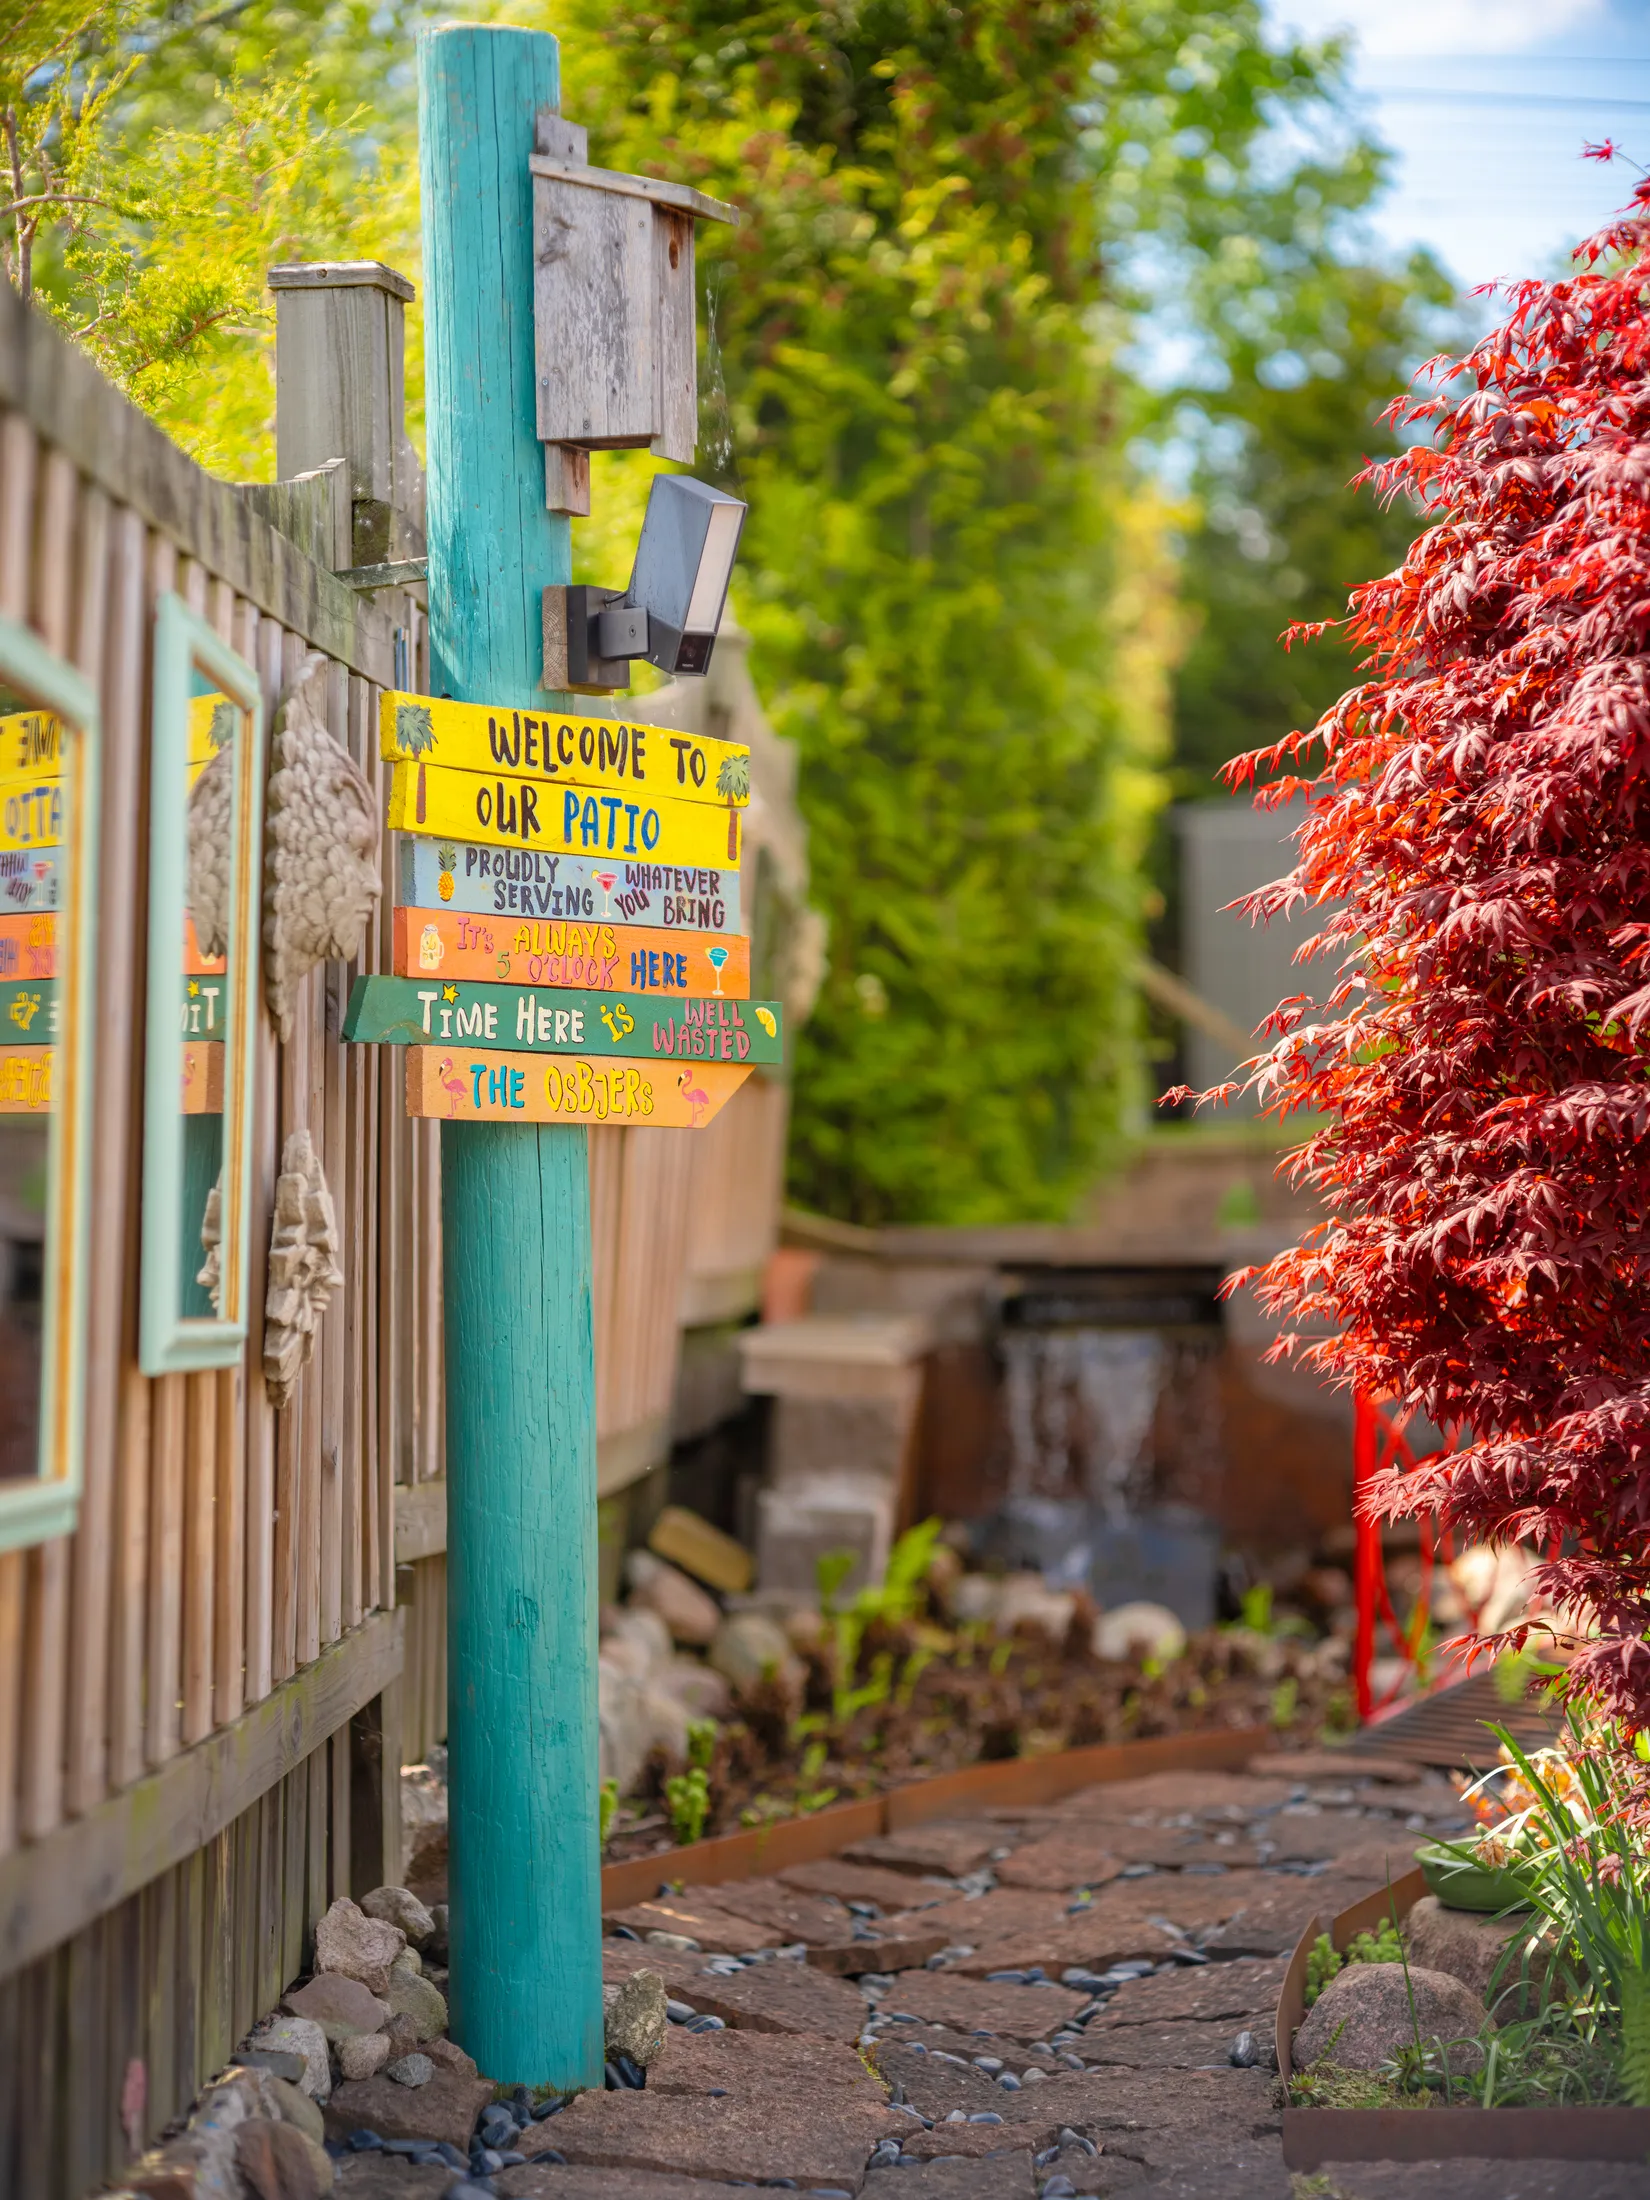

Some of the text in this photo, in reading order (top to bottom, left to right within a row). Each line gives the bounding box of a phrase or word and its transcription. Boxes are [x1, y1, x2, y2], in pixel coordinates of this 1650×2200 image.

[488, 711, 706, 788] WELCOME TO
[476, 781, 660, 854] OUR PATIO
[465, 846, 559, 884] PROUDLY
[625, 863, 720, 896] WHATEVER
[493, 880, 594, 916] SERVING
[614, 888, 725, 928] YOU BRING
[513, 921, 617, 959] ALWAYS
[495, 949, 688, 990] 5 O'CLOCK HERE
[417, 990, 498, 1040] TIME
[516, 994, 586, 1045] HERE
[684, 999, 746, 1028] WELL
[652, 1017, 751, 1060] WASTED
[470, 1064, 525, 1109] THE
